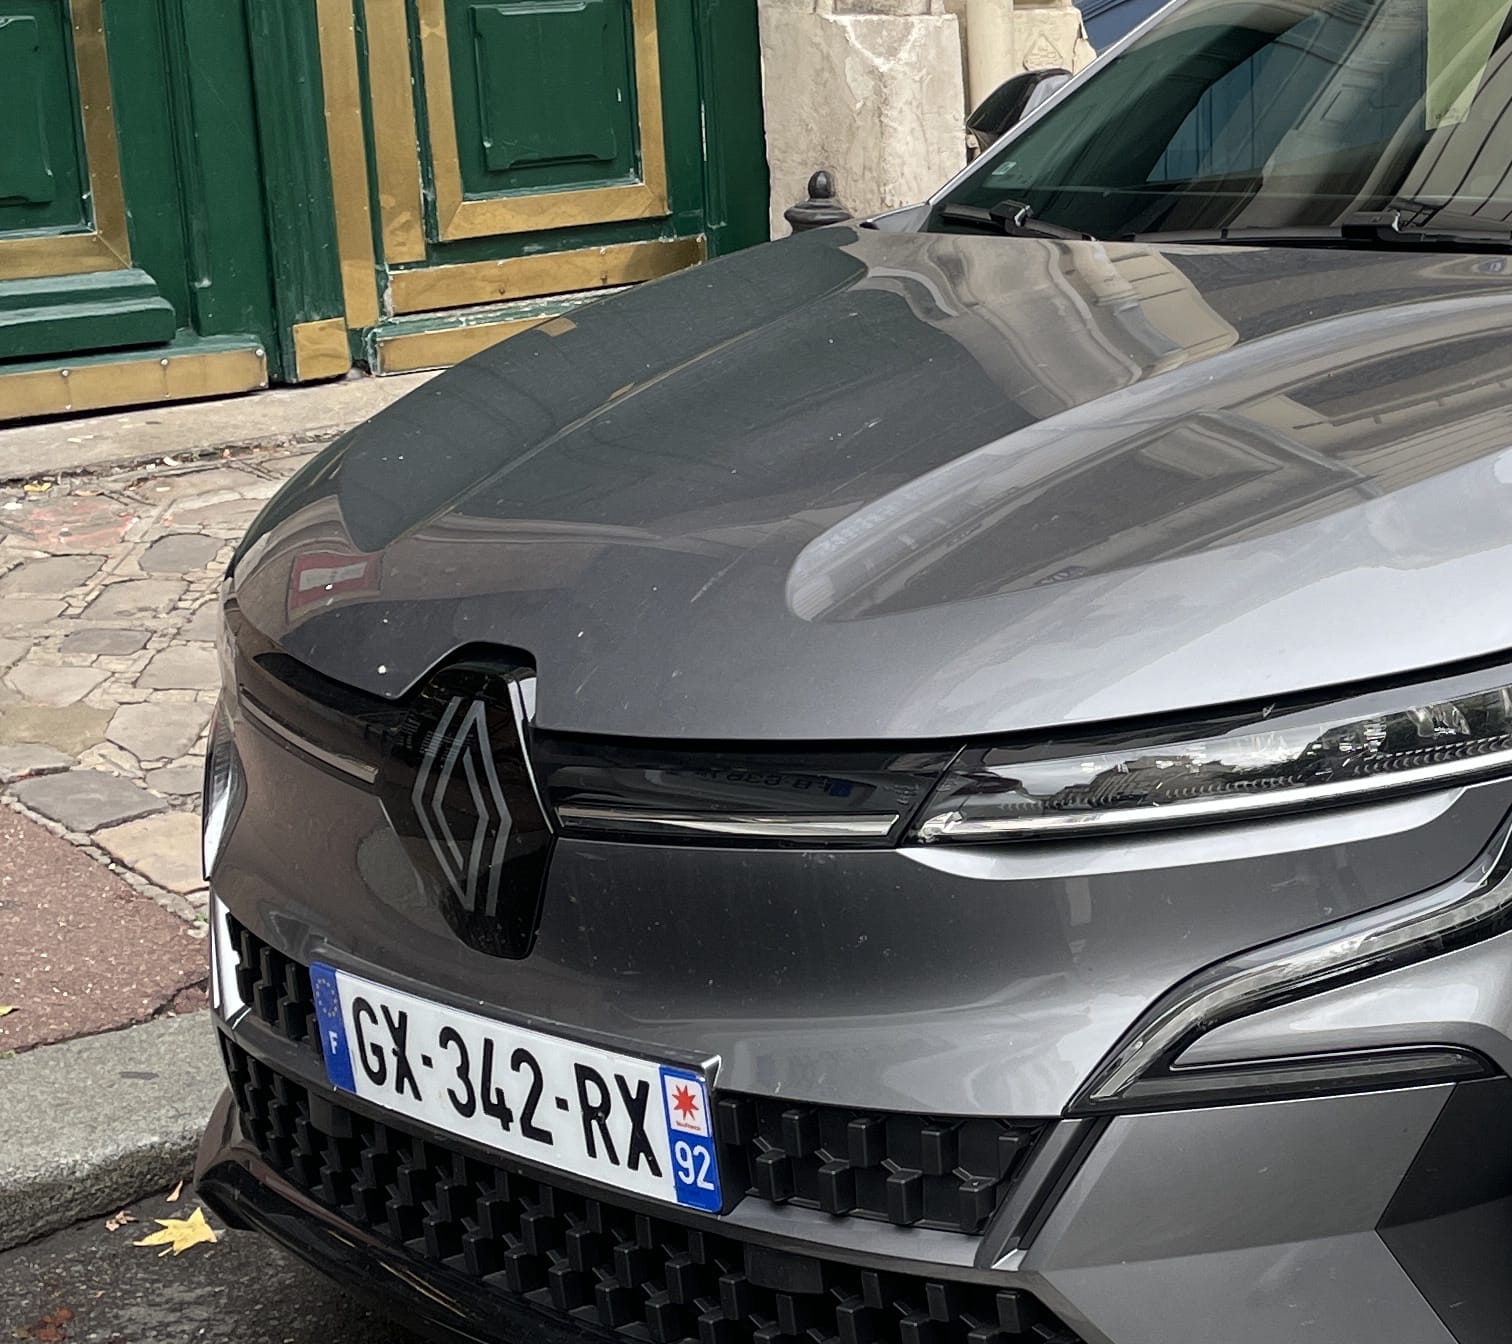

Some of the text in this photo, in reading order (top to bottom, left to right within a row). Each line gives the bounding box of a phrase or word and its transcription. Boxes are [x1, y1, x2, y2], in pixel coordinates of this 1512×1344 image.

[328, 1030, 339, 1054] F
[353, 997, 662, 1178] GX-342-RX
[674, 1141, 715, 1190] 92
